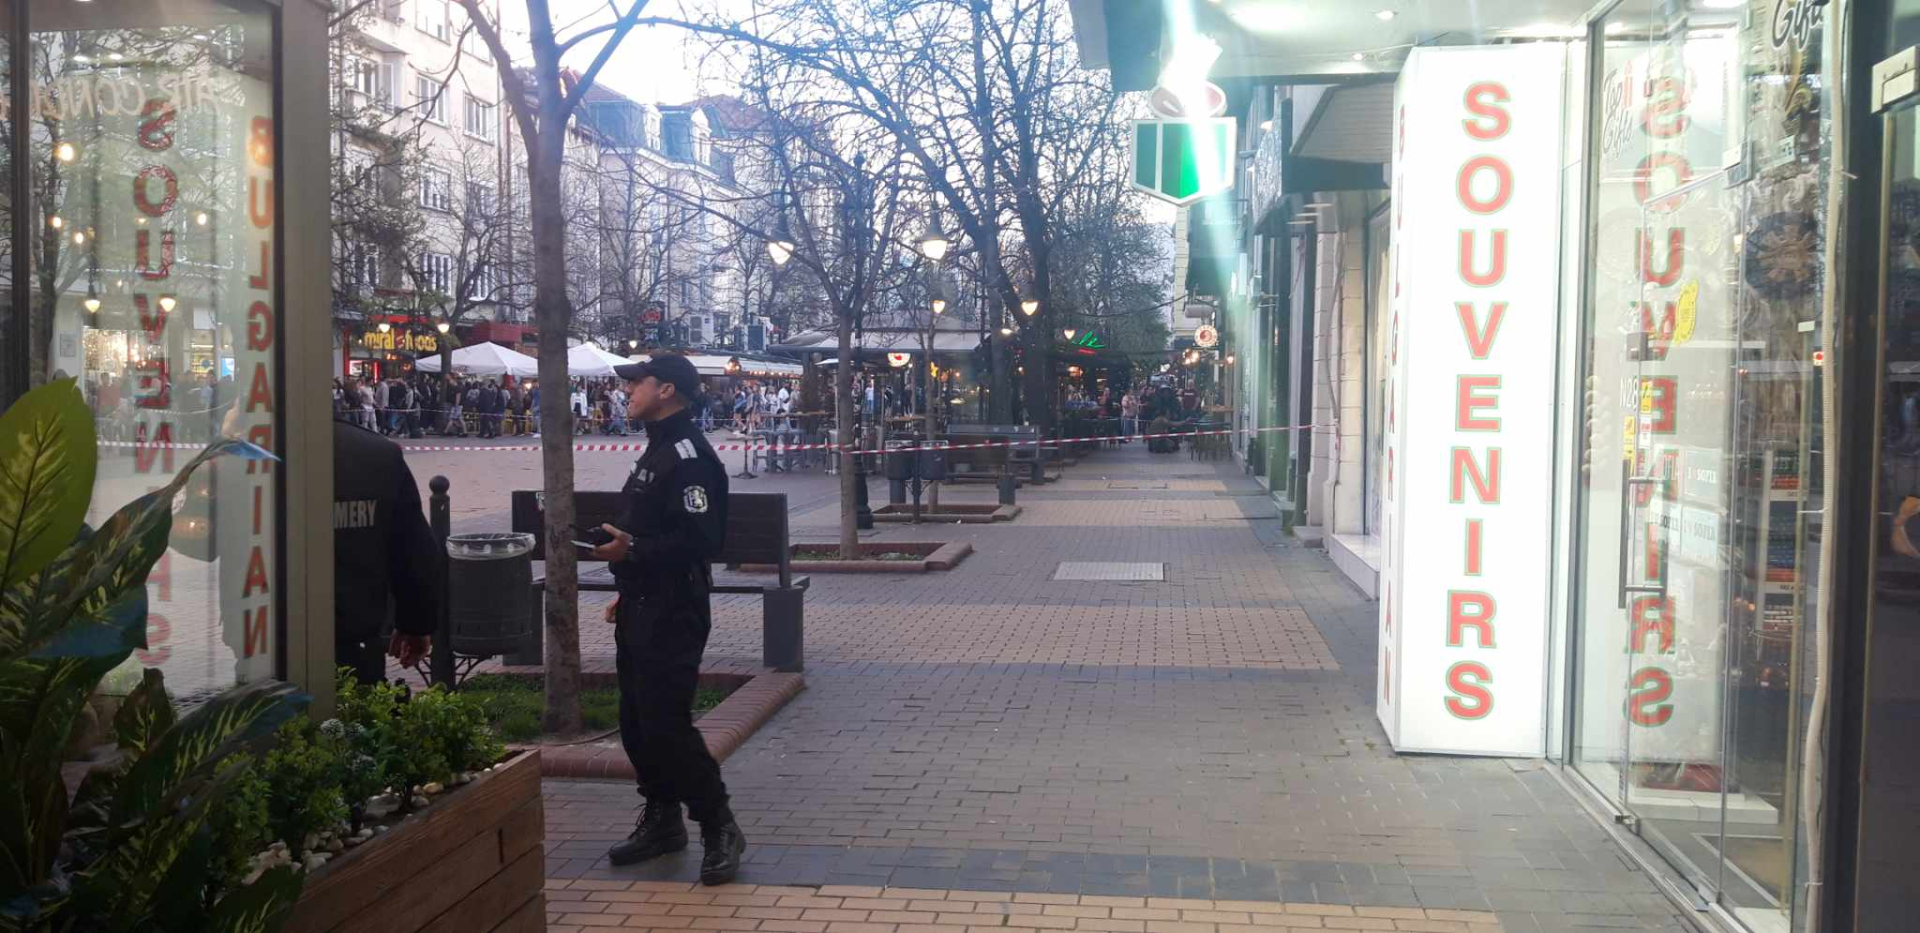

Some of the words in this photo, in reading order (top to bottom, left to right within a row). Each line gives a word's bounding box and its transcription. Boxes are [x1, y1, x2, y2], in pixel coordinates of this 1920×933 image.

[364, 328, 395, 350] miral
[1383, 104, 1405, 706] BULGARIAN
[1443, 80, 1514, 721] SOUVENIRS
[334, 500, 376, 529] MERY
